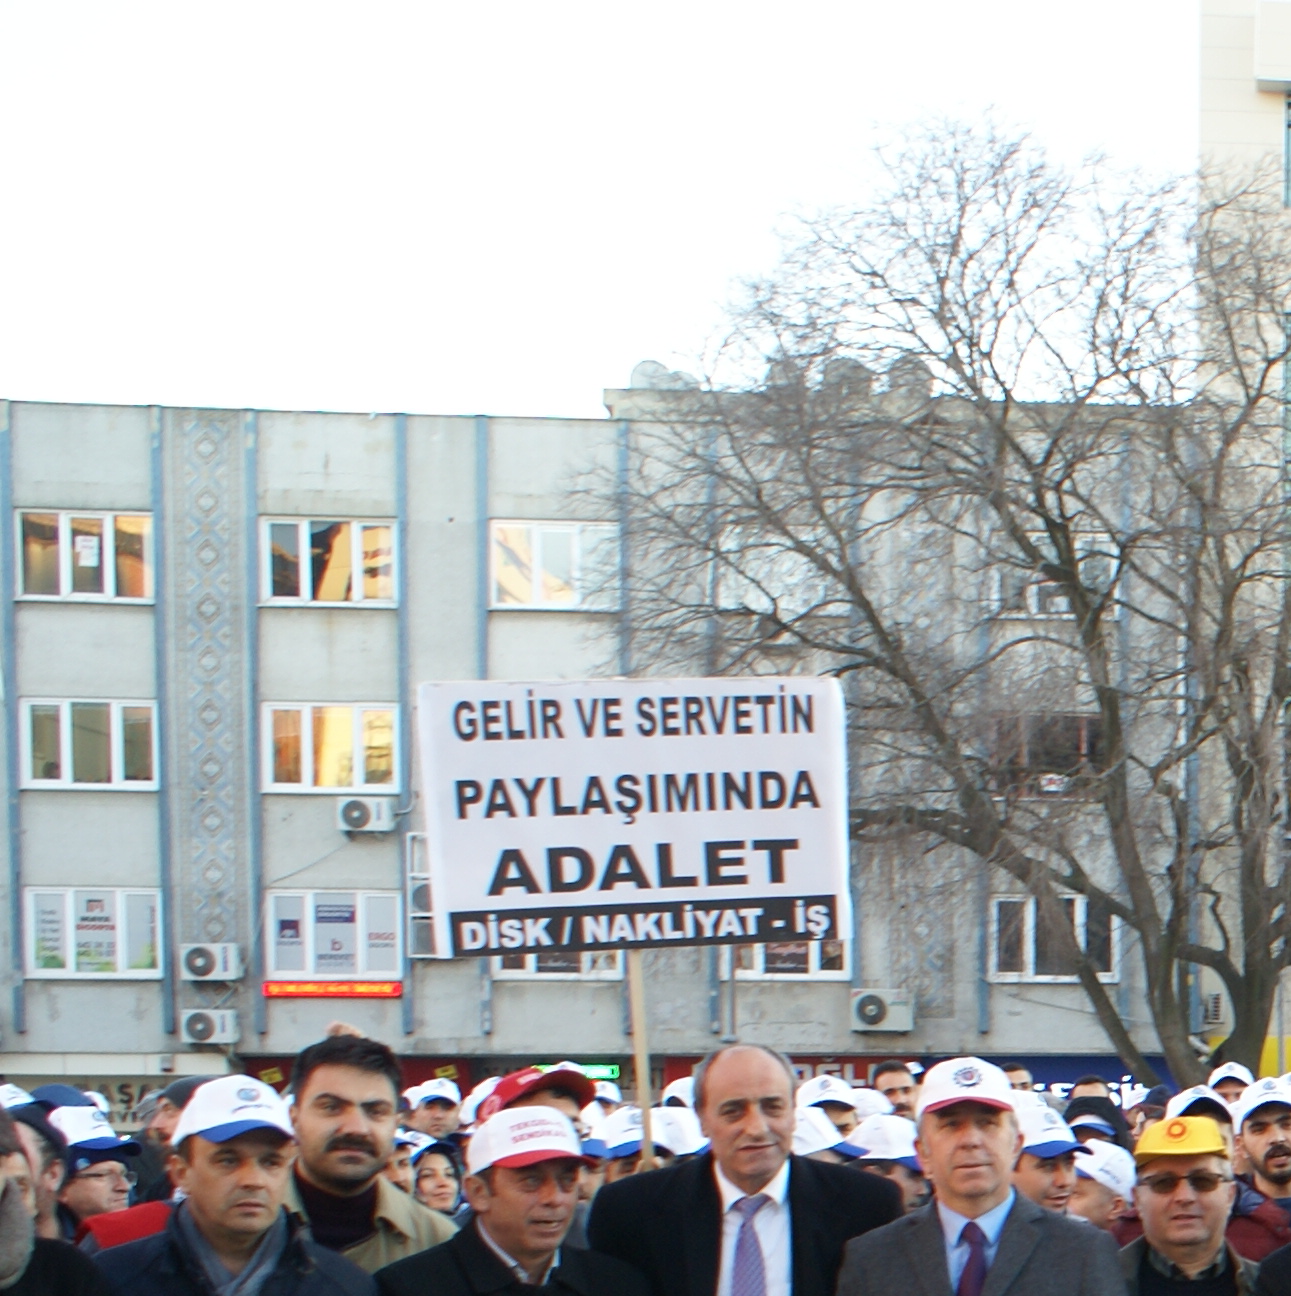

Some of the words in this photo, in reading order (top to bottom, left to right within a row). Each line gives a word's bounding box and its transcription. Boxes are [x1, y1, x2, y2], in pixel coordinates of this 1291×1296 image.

[453, 689, 565, 742] GELİR
[574, 697, 624, 738] VE
[636, 685, 815, 737] SERVETİN
[455, 770, 821, 825] PAYLAŞIMINDA
[487, 839, 800, 897] ADALET
[460, 914, 553, 951] DİSK
[561, 917, 573, 945] /
[581, 905, 764, 944] NAKLİYAT
[795, 900, 831, 939] İŞ
